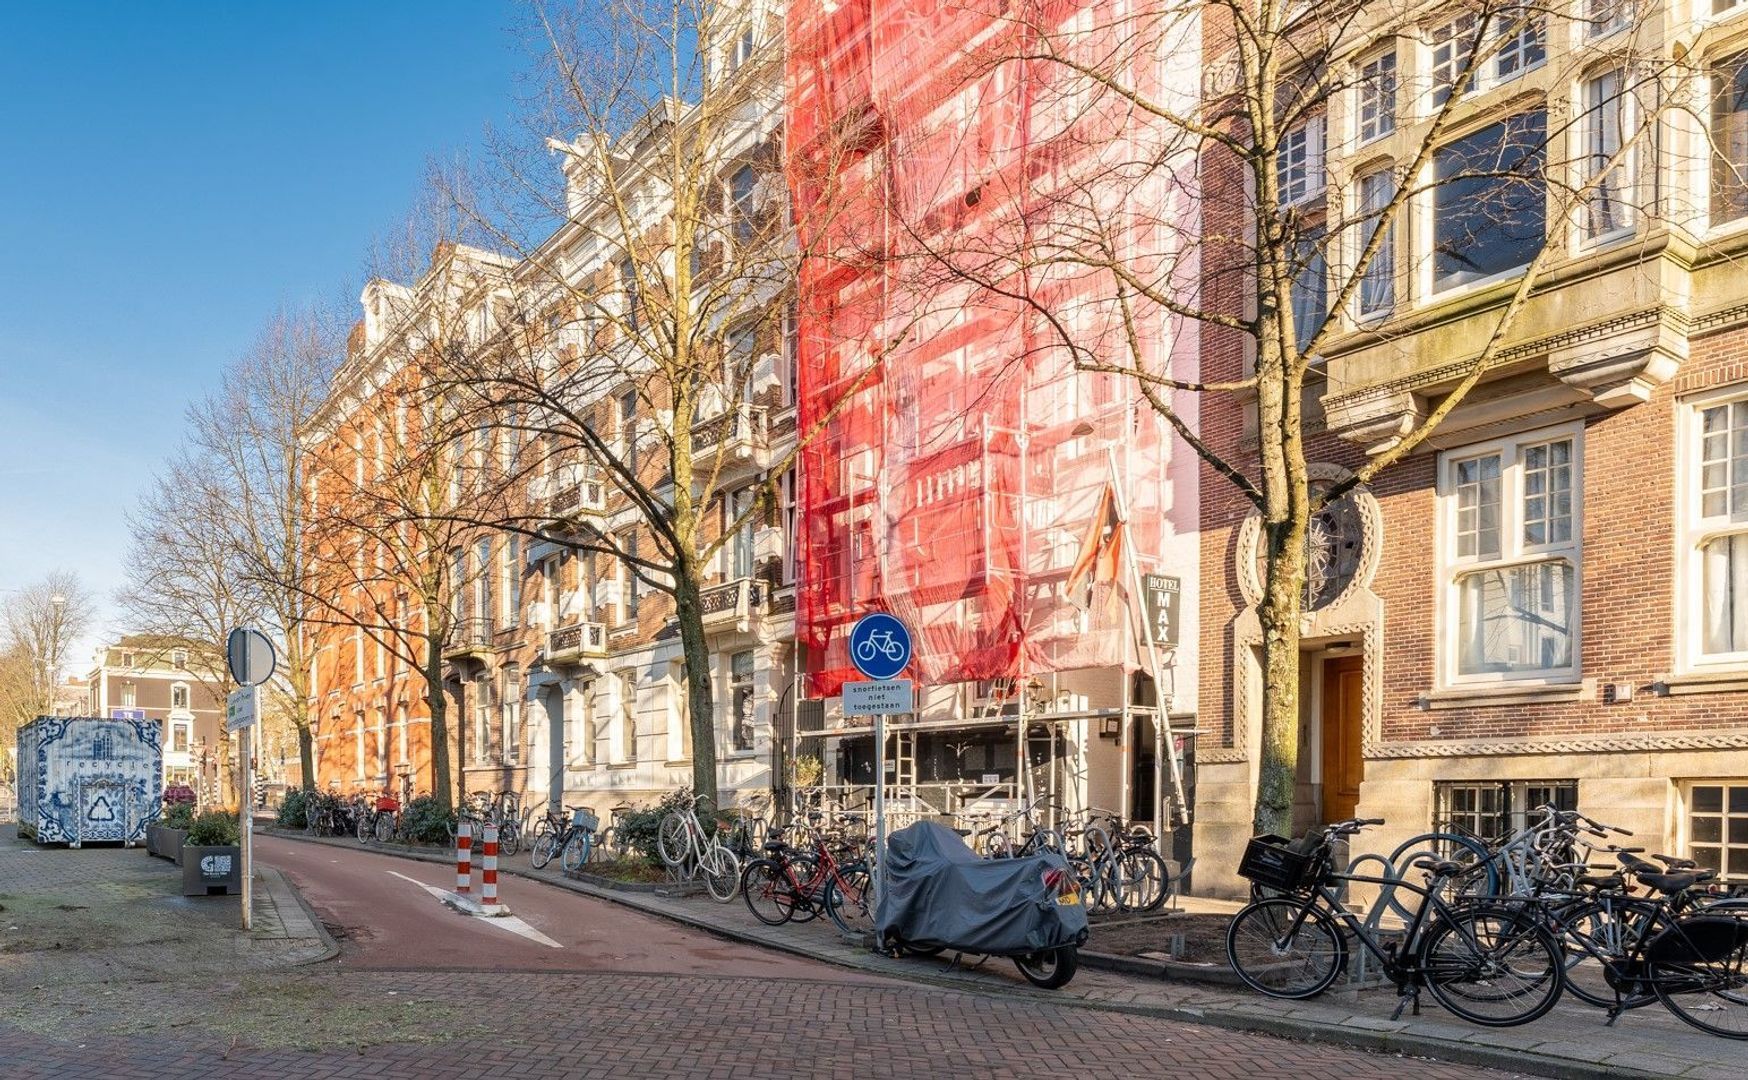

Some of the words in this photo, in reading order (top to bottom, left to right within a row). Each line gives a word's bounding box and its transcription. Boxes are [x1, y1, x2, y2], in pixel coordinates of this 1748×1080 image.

[1150, 577, 1179, 590] HOTEL
[1157, 592, 1170, 642] MAX
[852, 684, 901, 693] snorfietsen
[853, 702, 900, 711] toegestaan
[66, 759, 149, 769] recycle
